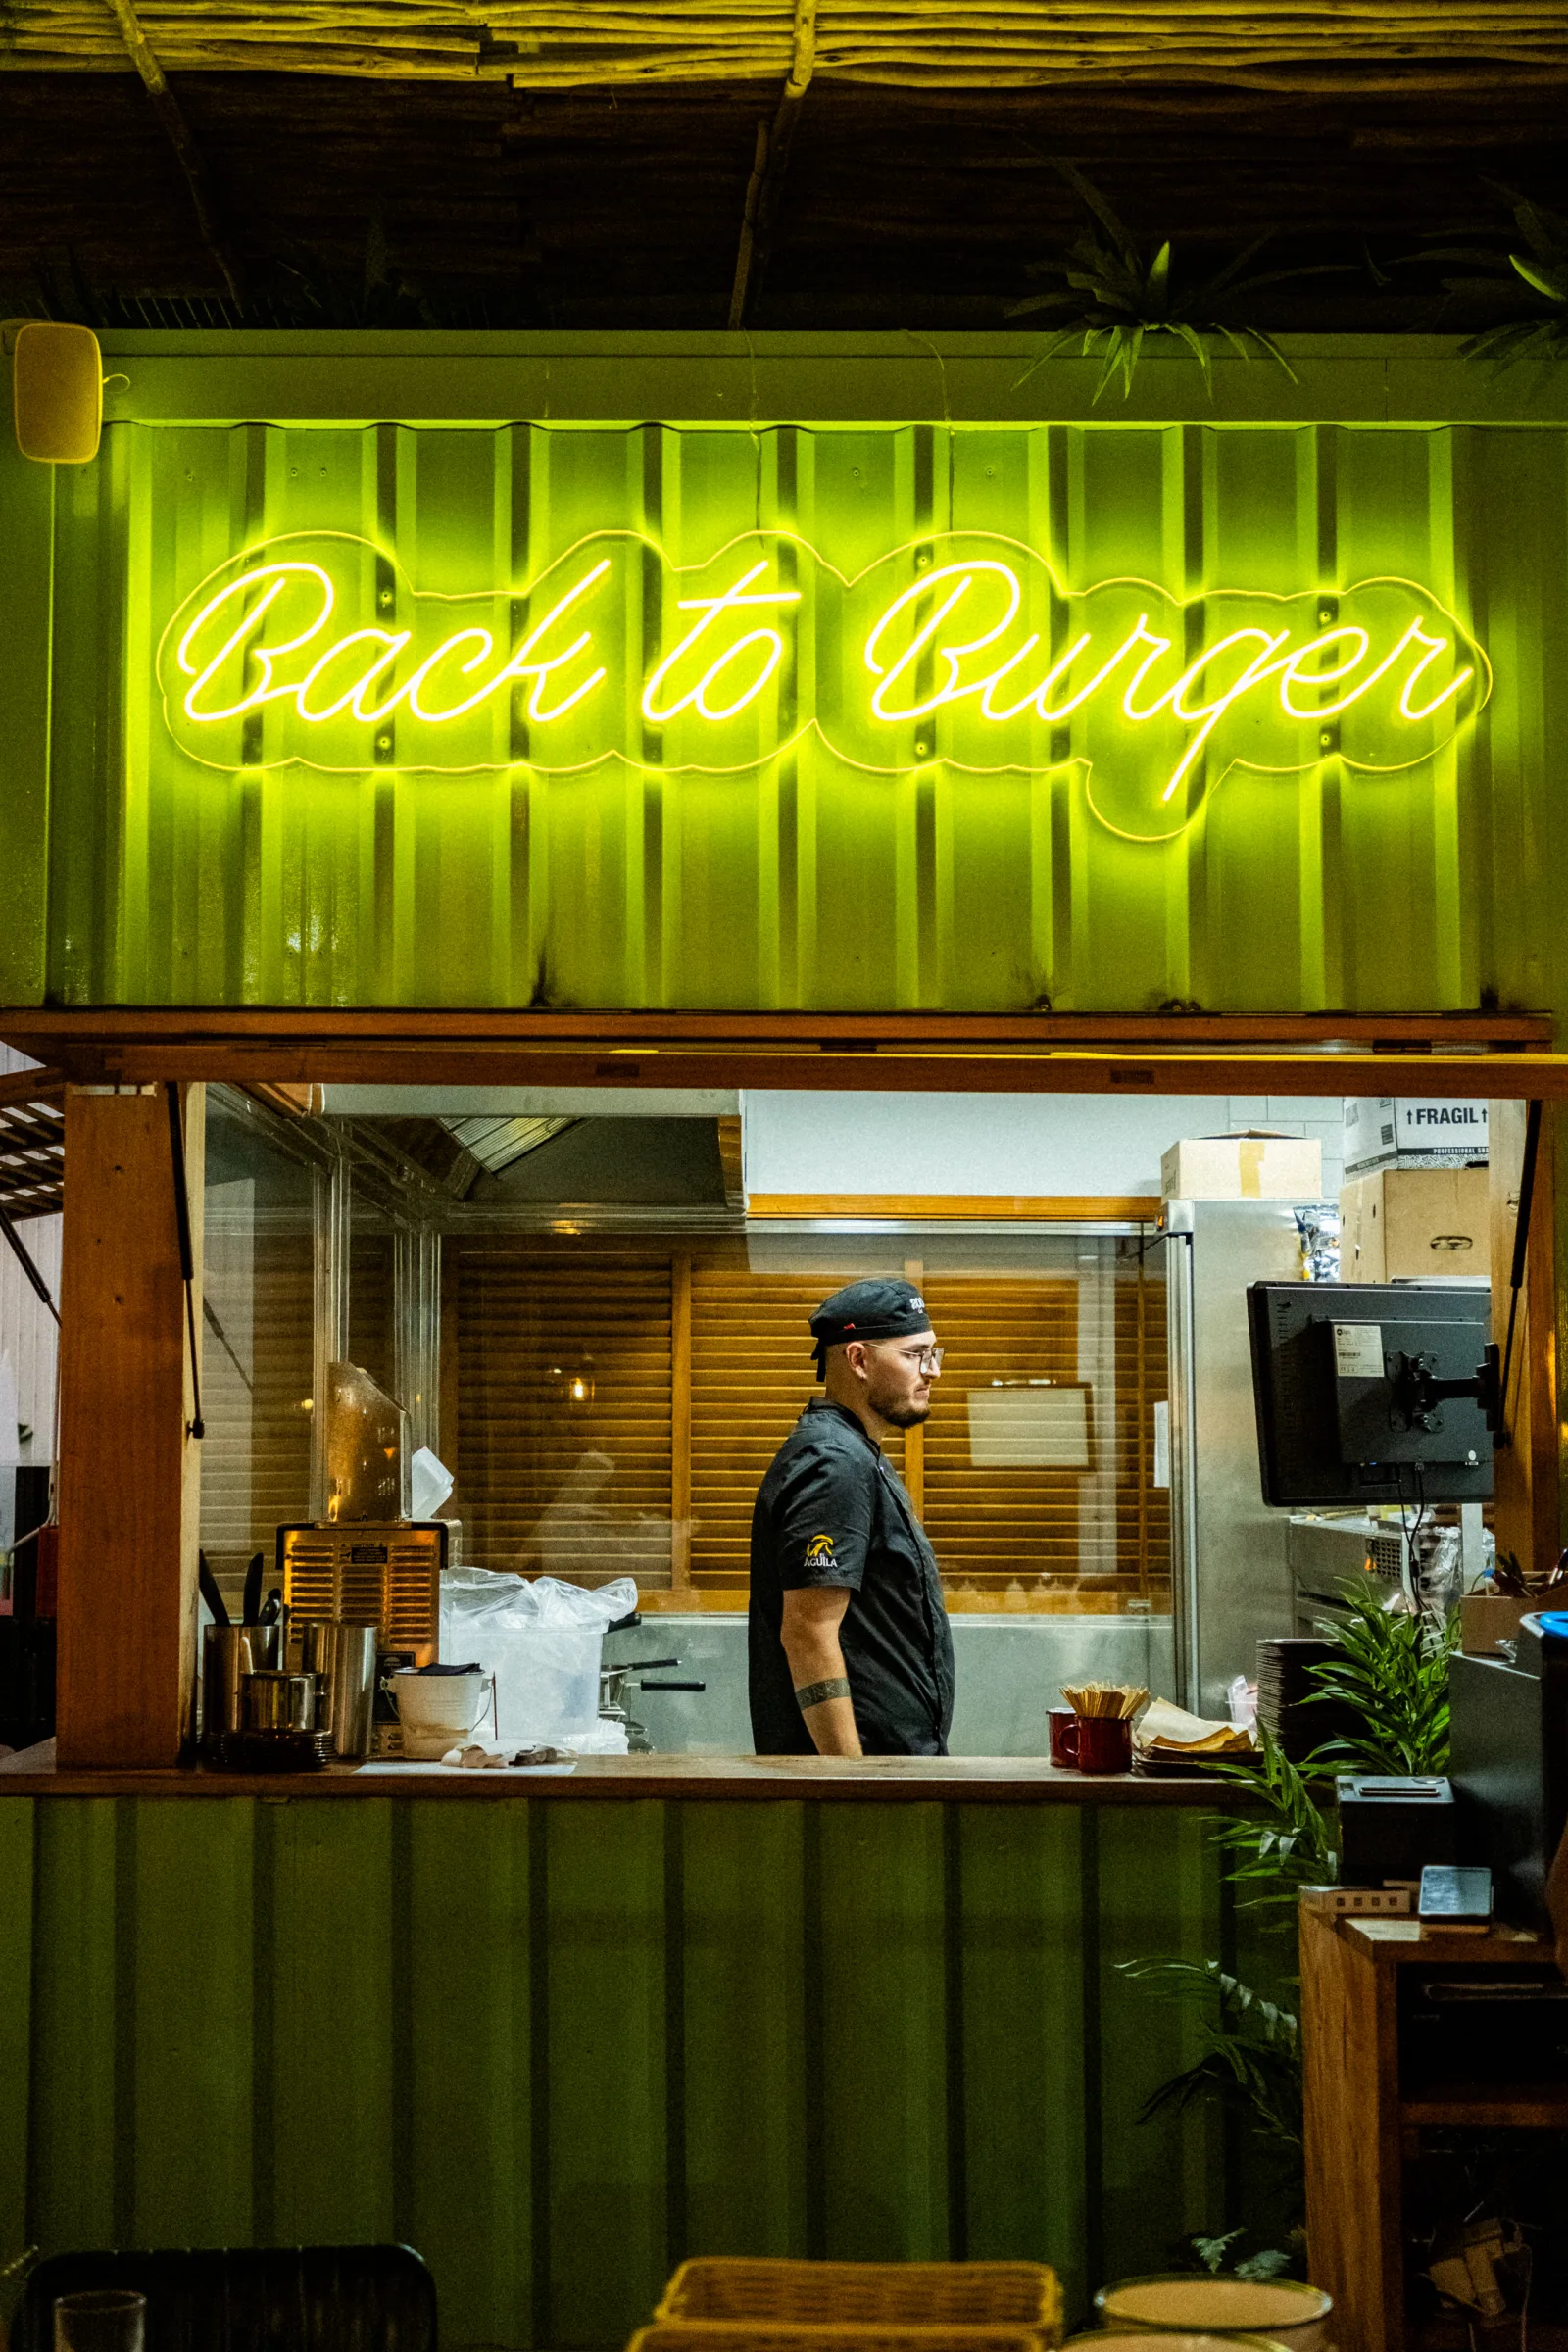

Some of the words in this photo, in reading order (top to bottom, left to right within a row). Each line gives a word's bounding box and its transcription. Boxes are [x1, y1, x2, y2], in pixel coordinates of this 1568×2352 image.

[176, 559, 610, 723] Back
[640, 560, 802, 722] to
[863, 559, 1474, 802] Burger
[1416, 1107, 1478, 1125] FRAGIL
